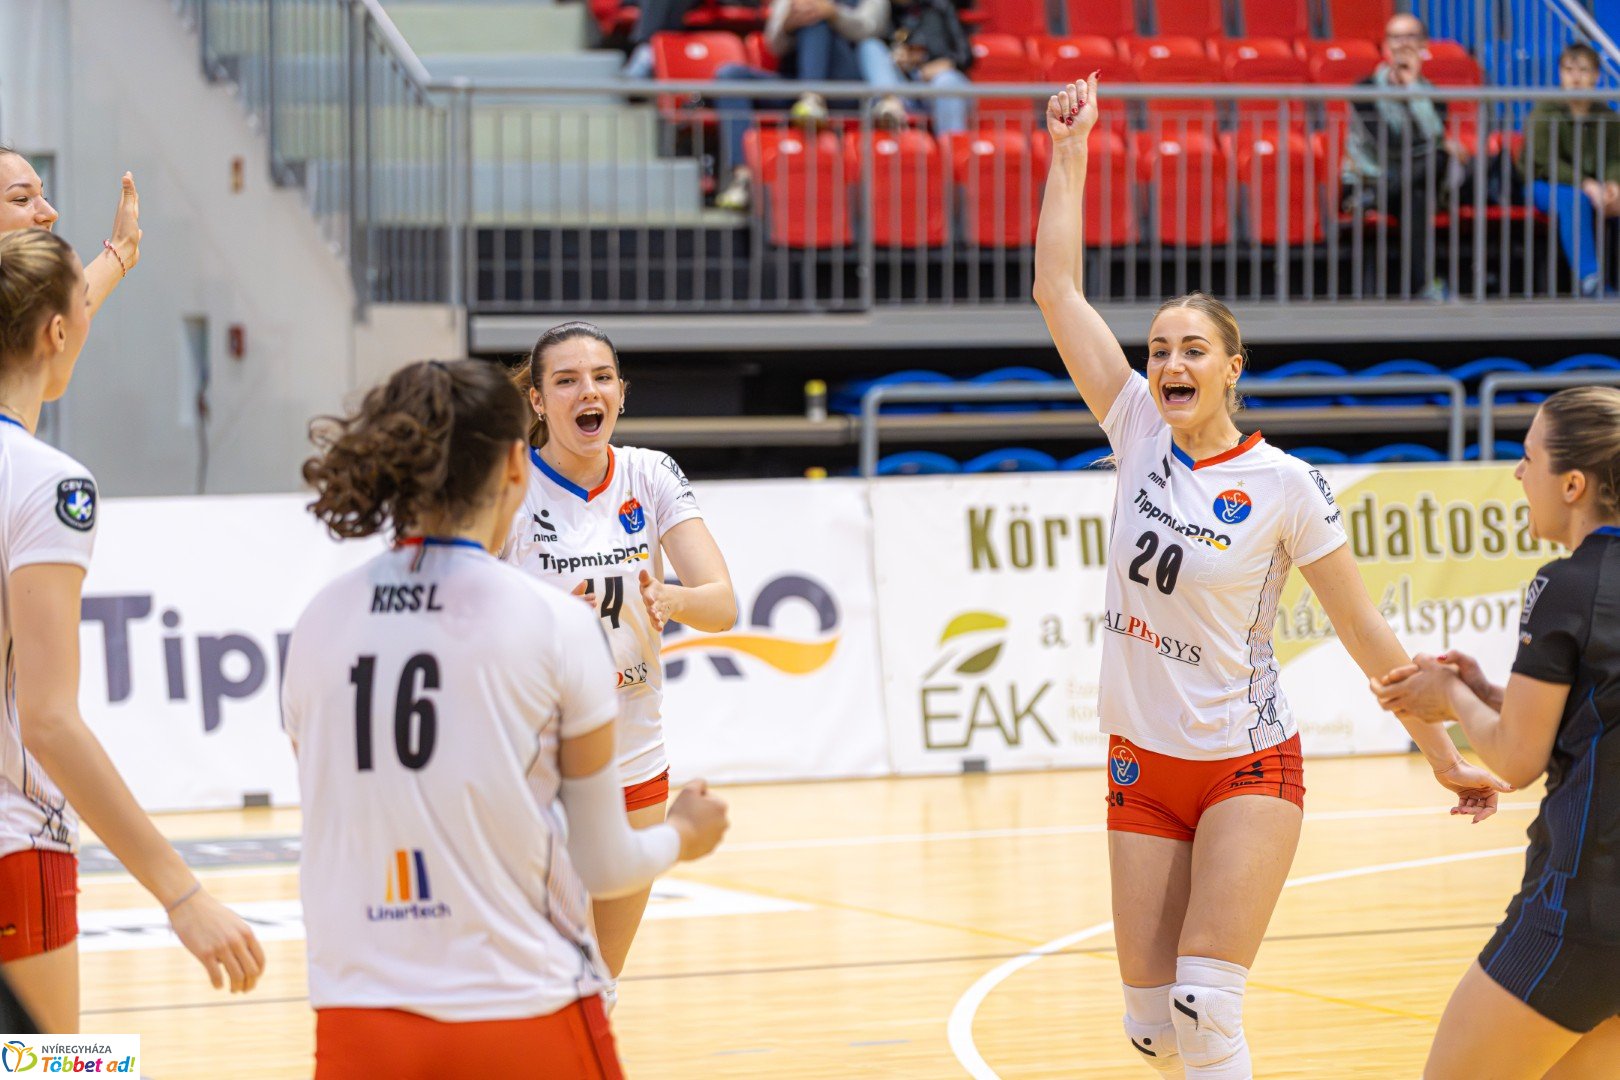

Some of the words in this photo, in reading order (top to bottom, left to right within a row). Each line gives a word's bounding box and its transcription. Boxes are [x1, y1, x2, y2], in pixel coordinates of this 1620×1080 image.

[1147, 471, 1168, 489] nine
[533, 533, 558, 543] nine
[1134, 488, 1232, 551] TippmixPRO
[1351, 496, 1568, 559] datosa
[539, 542, 650, 574] TippmixPRO
[1128, 530, 1184, 596] 20
[370, 584, 424, 613] KISS
[426, 583, 444, 612] L
[81, 593, 293, 732] Tip
[350, 652, 440, 773] 16
[921, 680, 1059, 750] EAK
